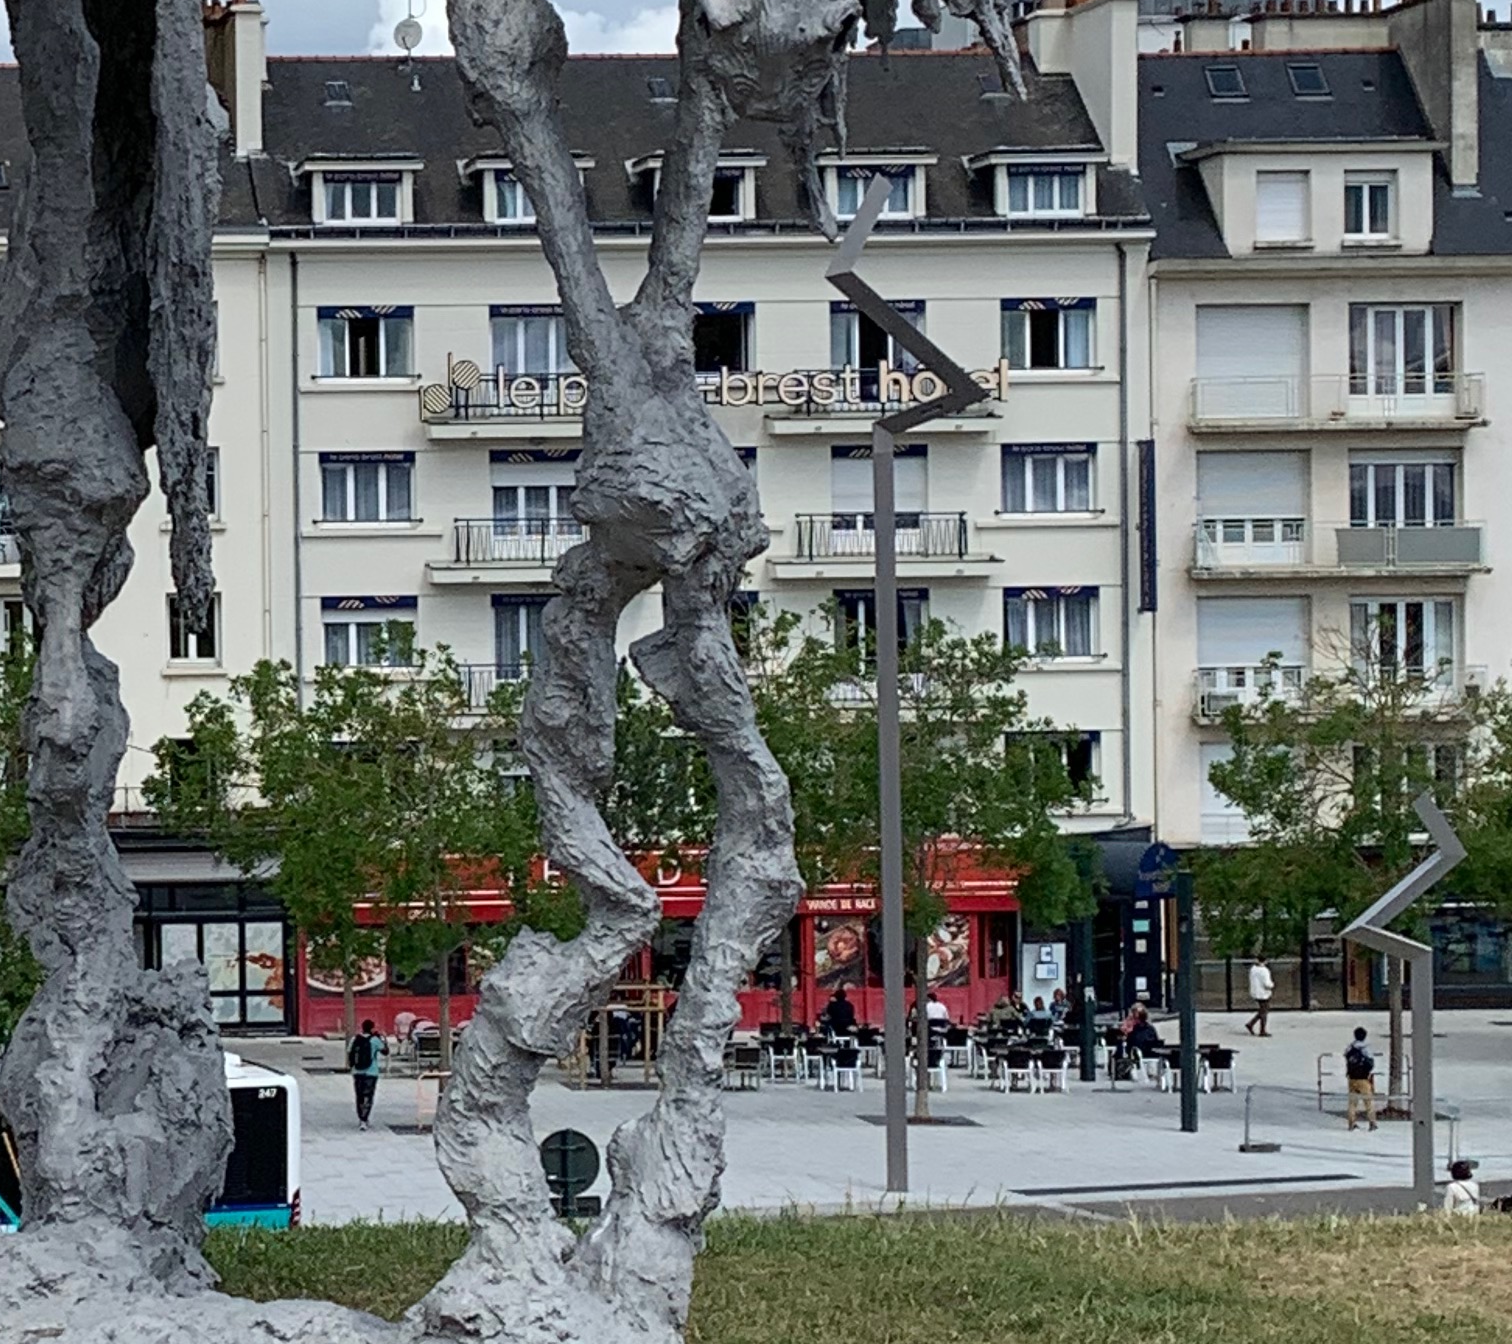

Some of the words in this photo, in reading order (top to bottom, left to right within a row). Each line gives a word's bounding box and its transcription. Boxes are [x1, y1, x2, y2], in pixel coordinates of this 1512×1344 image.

[498, 364, 541, 408] le
[879, 358, 1008, 404] hoel
[257, 1088, 277, 1099] 247
